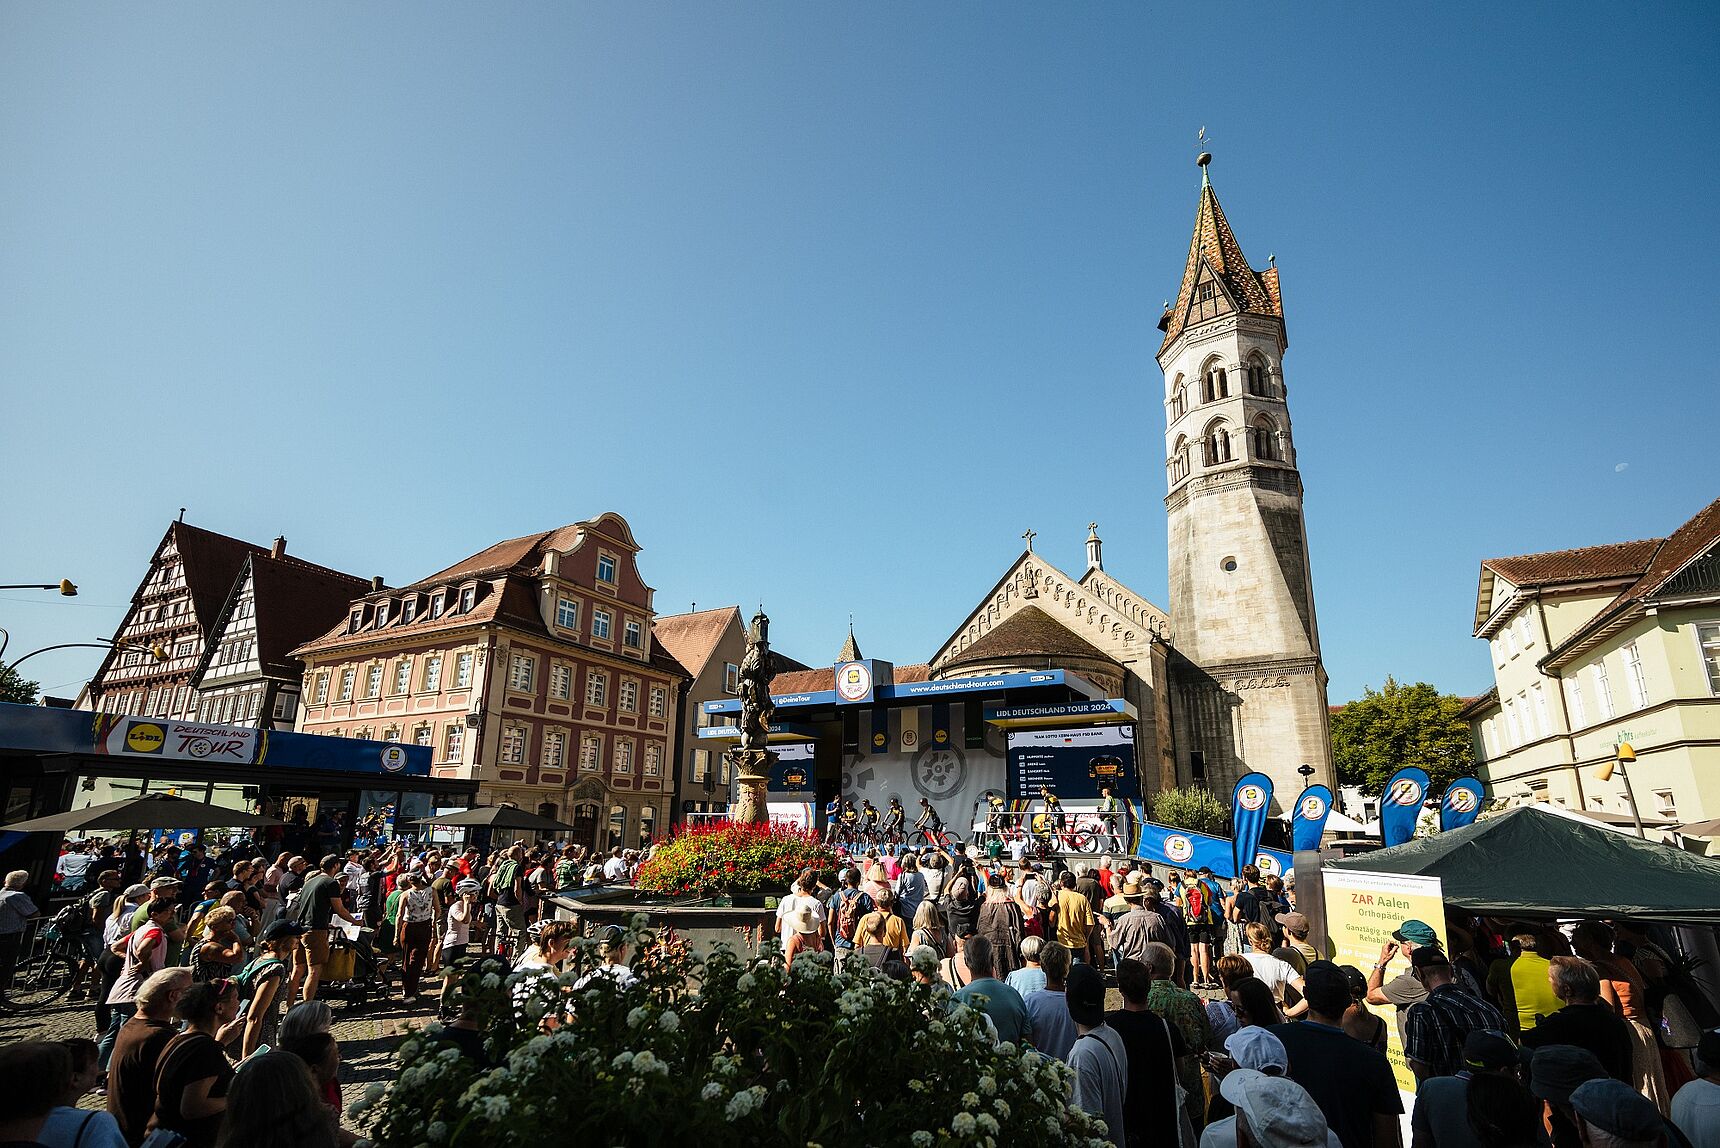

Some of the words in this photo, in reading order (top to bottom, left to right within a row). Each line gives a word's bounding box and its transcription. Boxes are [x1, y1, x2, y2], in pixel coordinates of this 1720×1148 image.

[910, 679, 1004, 693] www.deutschland-tour.com
[1012, 707, 1066, 716] DEUTSCHLAND
[1091, 703, 1111, 711] 2024
[173, 724, 251, 738] DEUTSCHLAND
[1351, 893, 1375, 905] ZAR
[1377, 896, 1410, 910] Aalen
[1358, 908, 1406, 921] Orthopädie
[1345, 923, 1381, 936] Ganztägig
